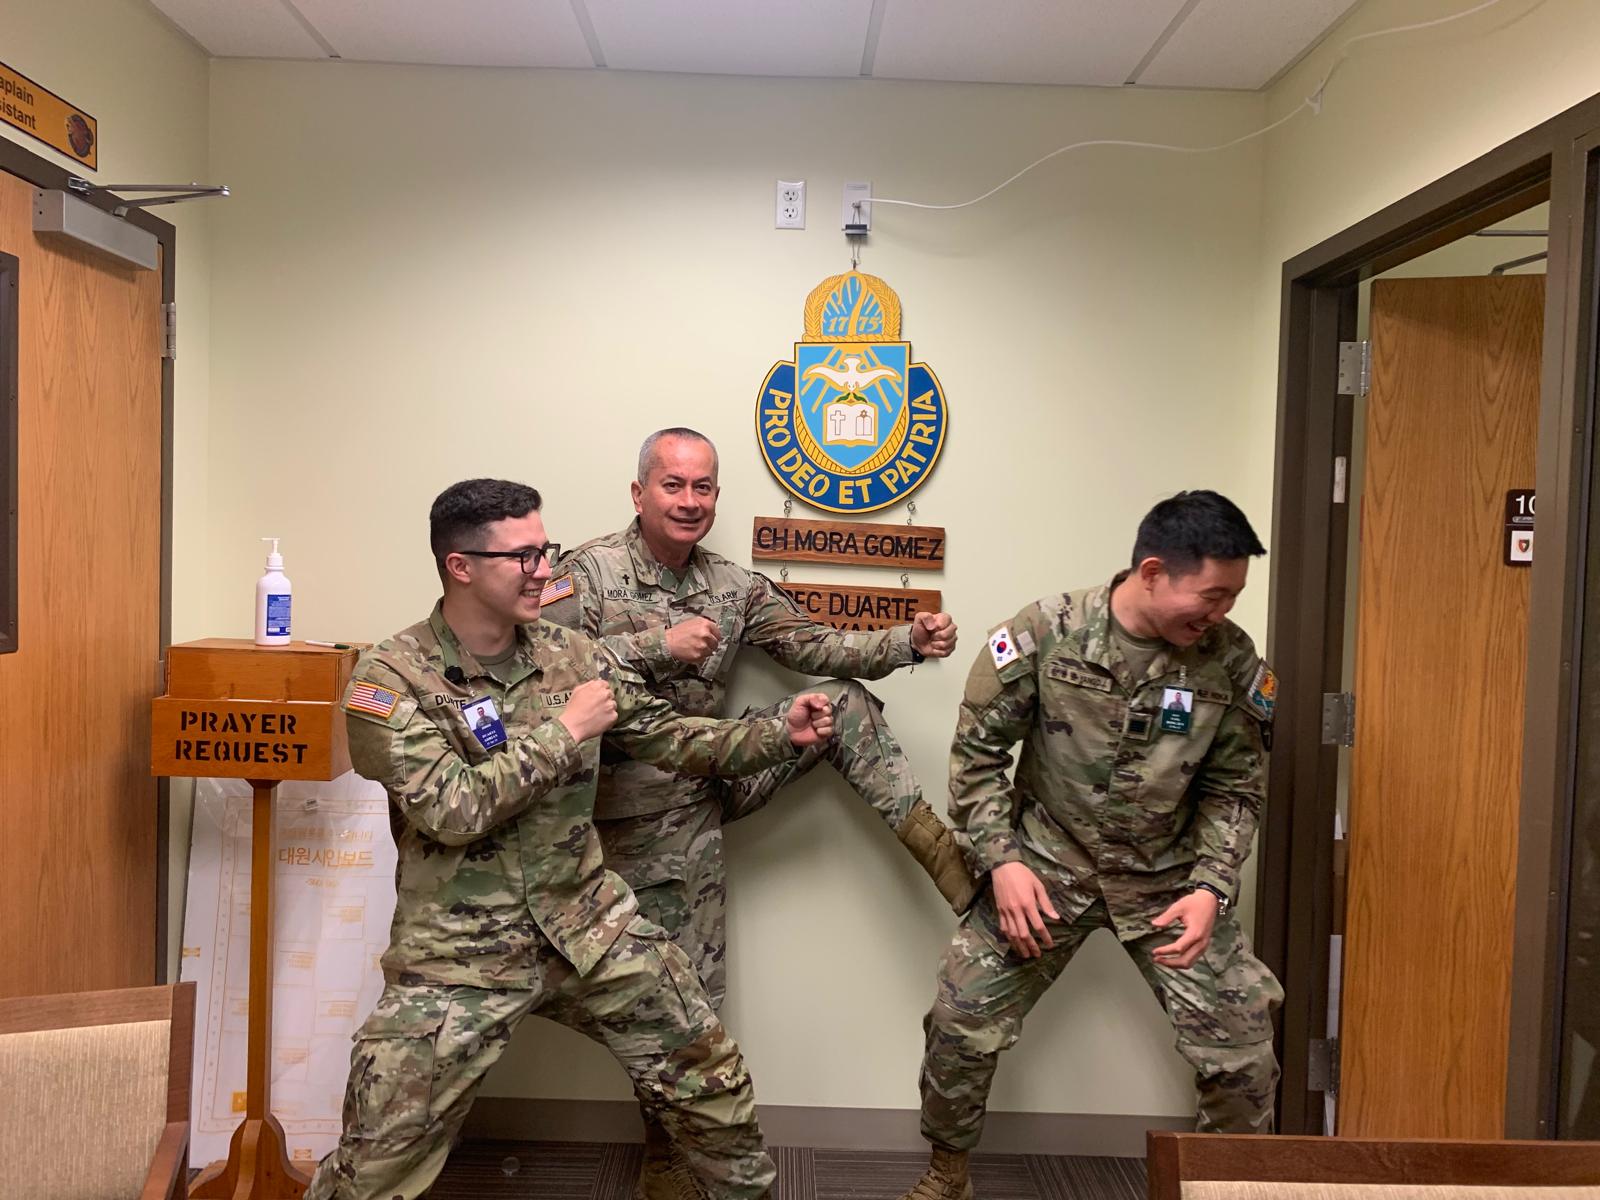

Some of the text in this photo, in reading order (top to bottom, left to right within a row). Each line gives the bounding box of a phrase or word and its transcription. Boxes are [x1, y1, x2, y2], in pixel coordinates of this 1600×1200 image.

[764, 388, 937, 504] PRO DEO ET PATRIA
[756, 526, 944, 561] CH MORA GOMEZ
[607, 590, 653, 602] MORA GOMEZ
[784, 588, 918, 621] FC DUARTE
[546, 692, 572, 706] U.S.A
[181, 711, 297, 735] PRAYER
[175, 740, 308, 764] REQUEST
